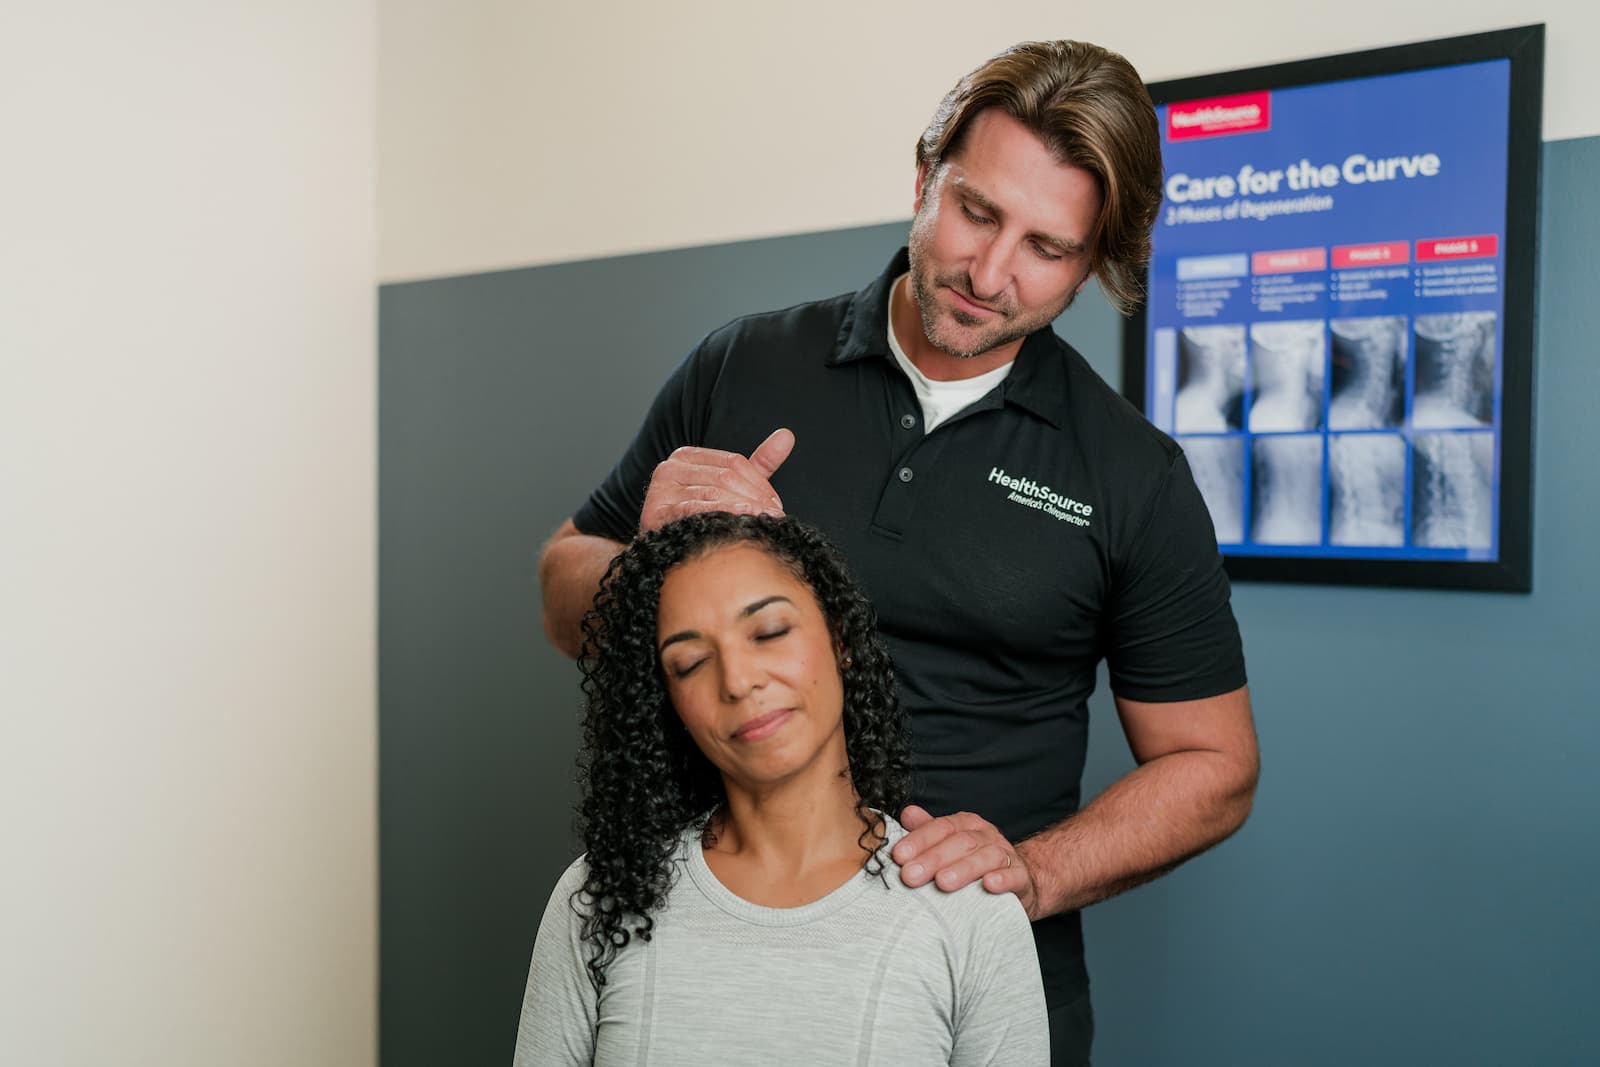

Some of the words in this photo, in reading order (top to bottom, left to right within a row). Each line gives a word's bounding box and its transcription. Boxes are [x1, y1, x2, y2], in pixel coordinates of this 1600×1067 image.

[1166, 173, 1236, 203] Care
[1237, 165, 1283, 195] for
[1287, 159, 1340, 190] the
[1342, 153, 1441, 184] Curve
[1177, 203, 1223, 223] Phases
[1223, 199, 1240, 220] of
[1241, 194, 1333, 221] Degeneration
[988, 467, 1093, 516] HealthSource
[1007, 491, 1043, 510] America's
